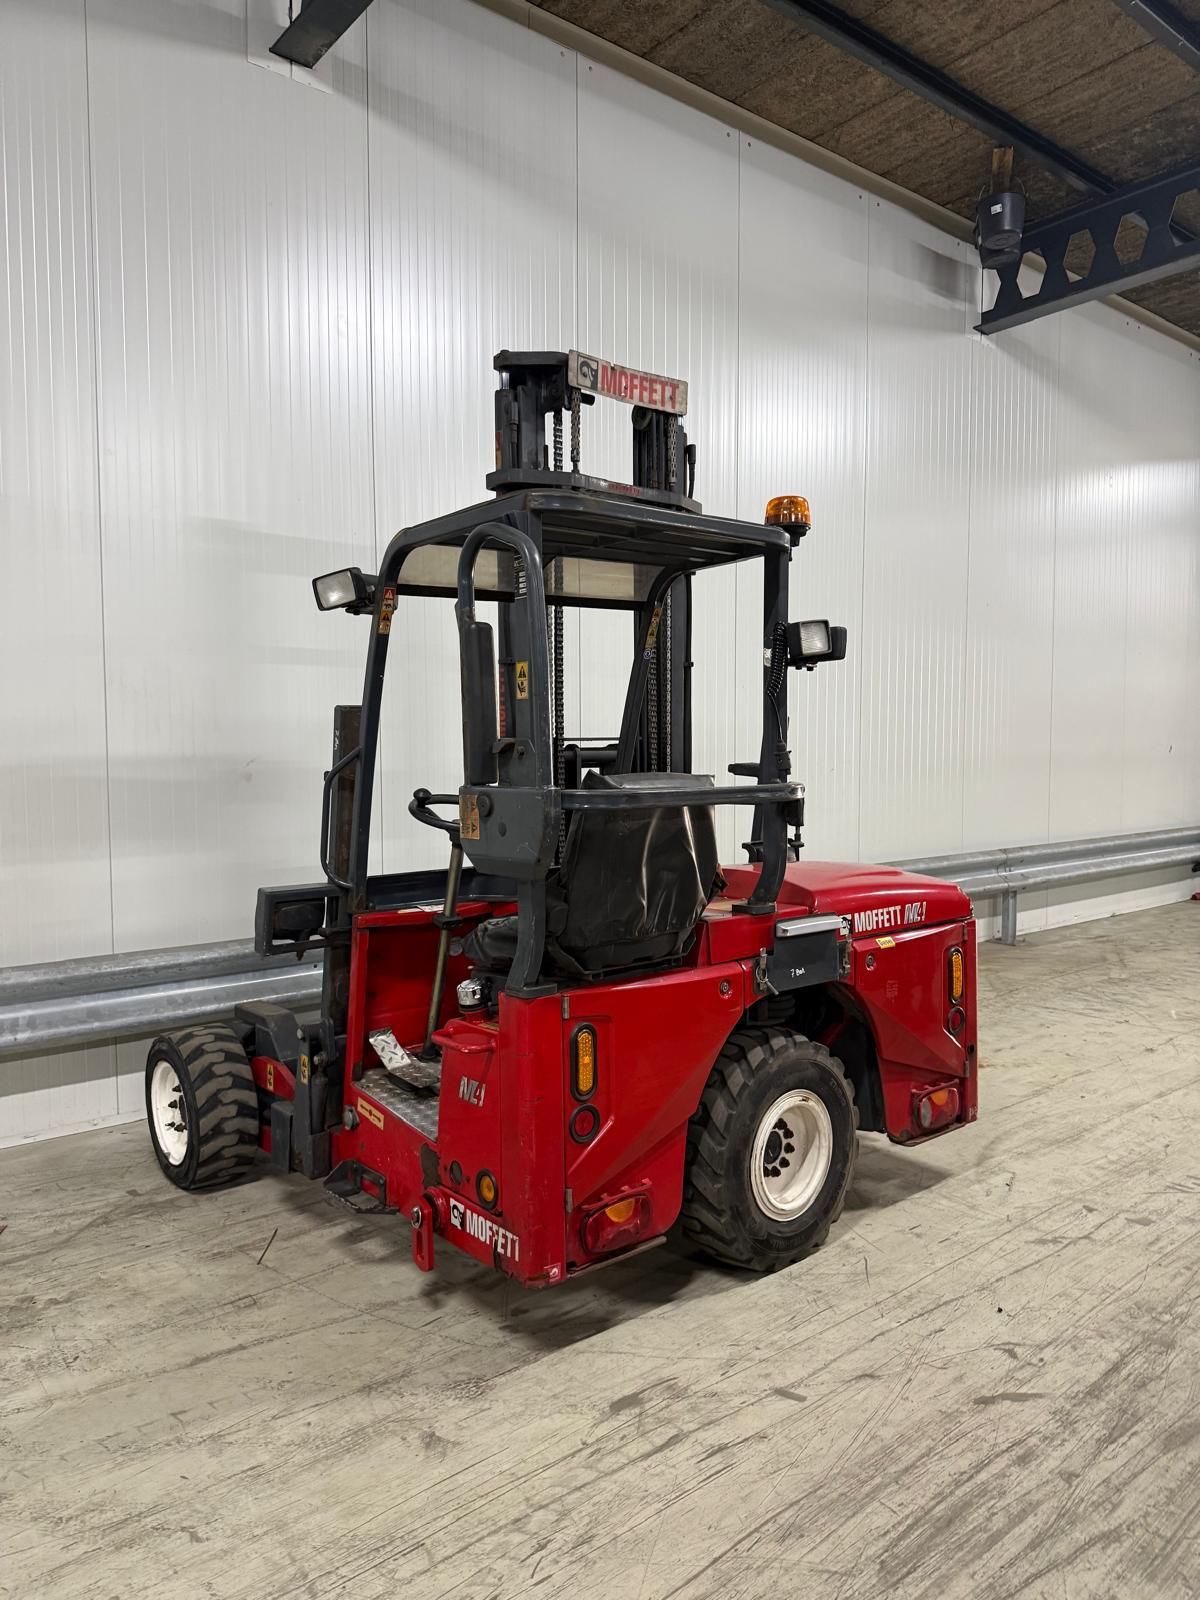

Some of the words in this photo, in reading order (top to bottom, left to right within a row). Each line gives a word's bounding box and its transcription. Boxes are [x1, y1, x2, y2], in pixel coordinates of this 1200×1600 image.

[601, 364, 679, 409] MOFFETT
[854, 905, 901, 933] MOFFETT
[466, 1209, 519, 1262] MOFFETT
